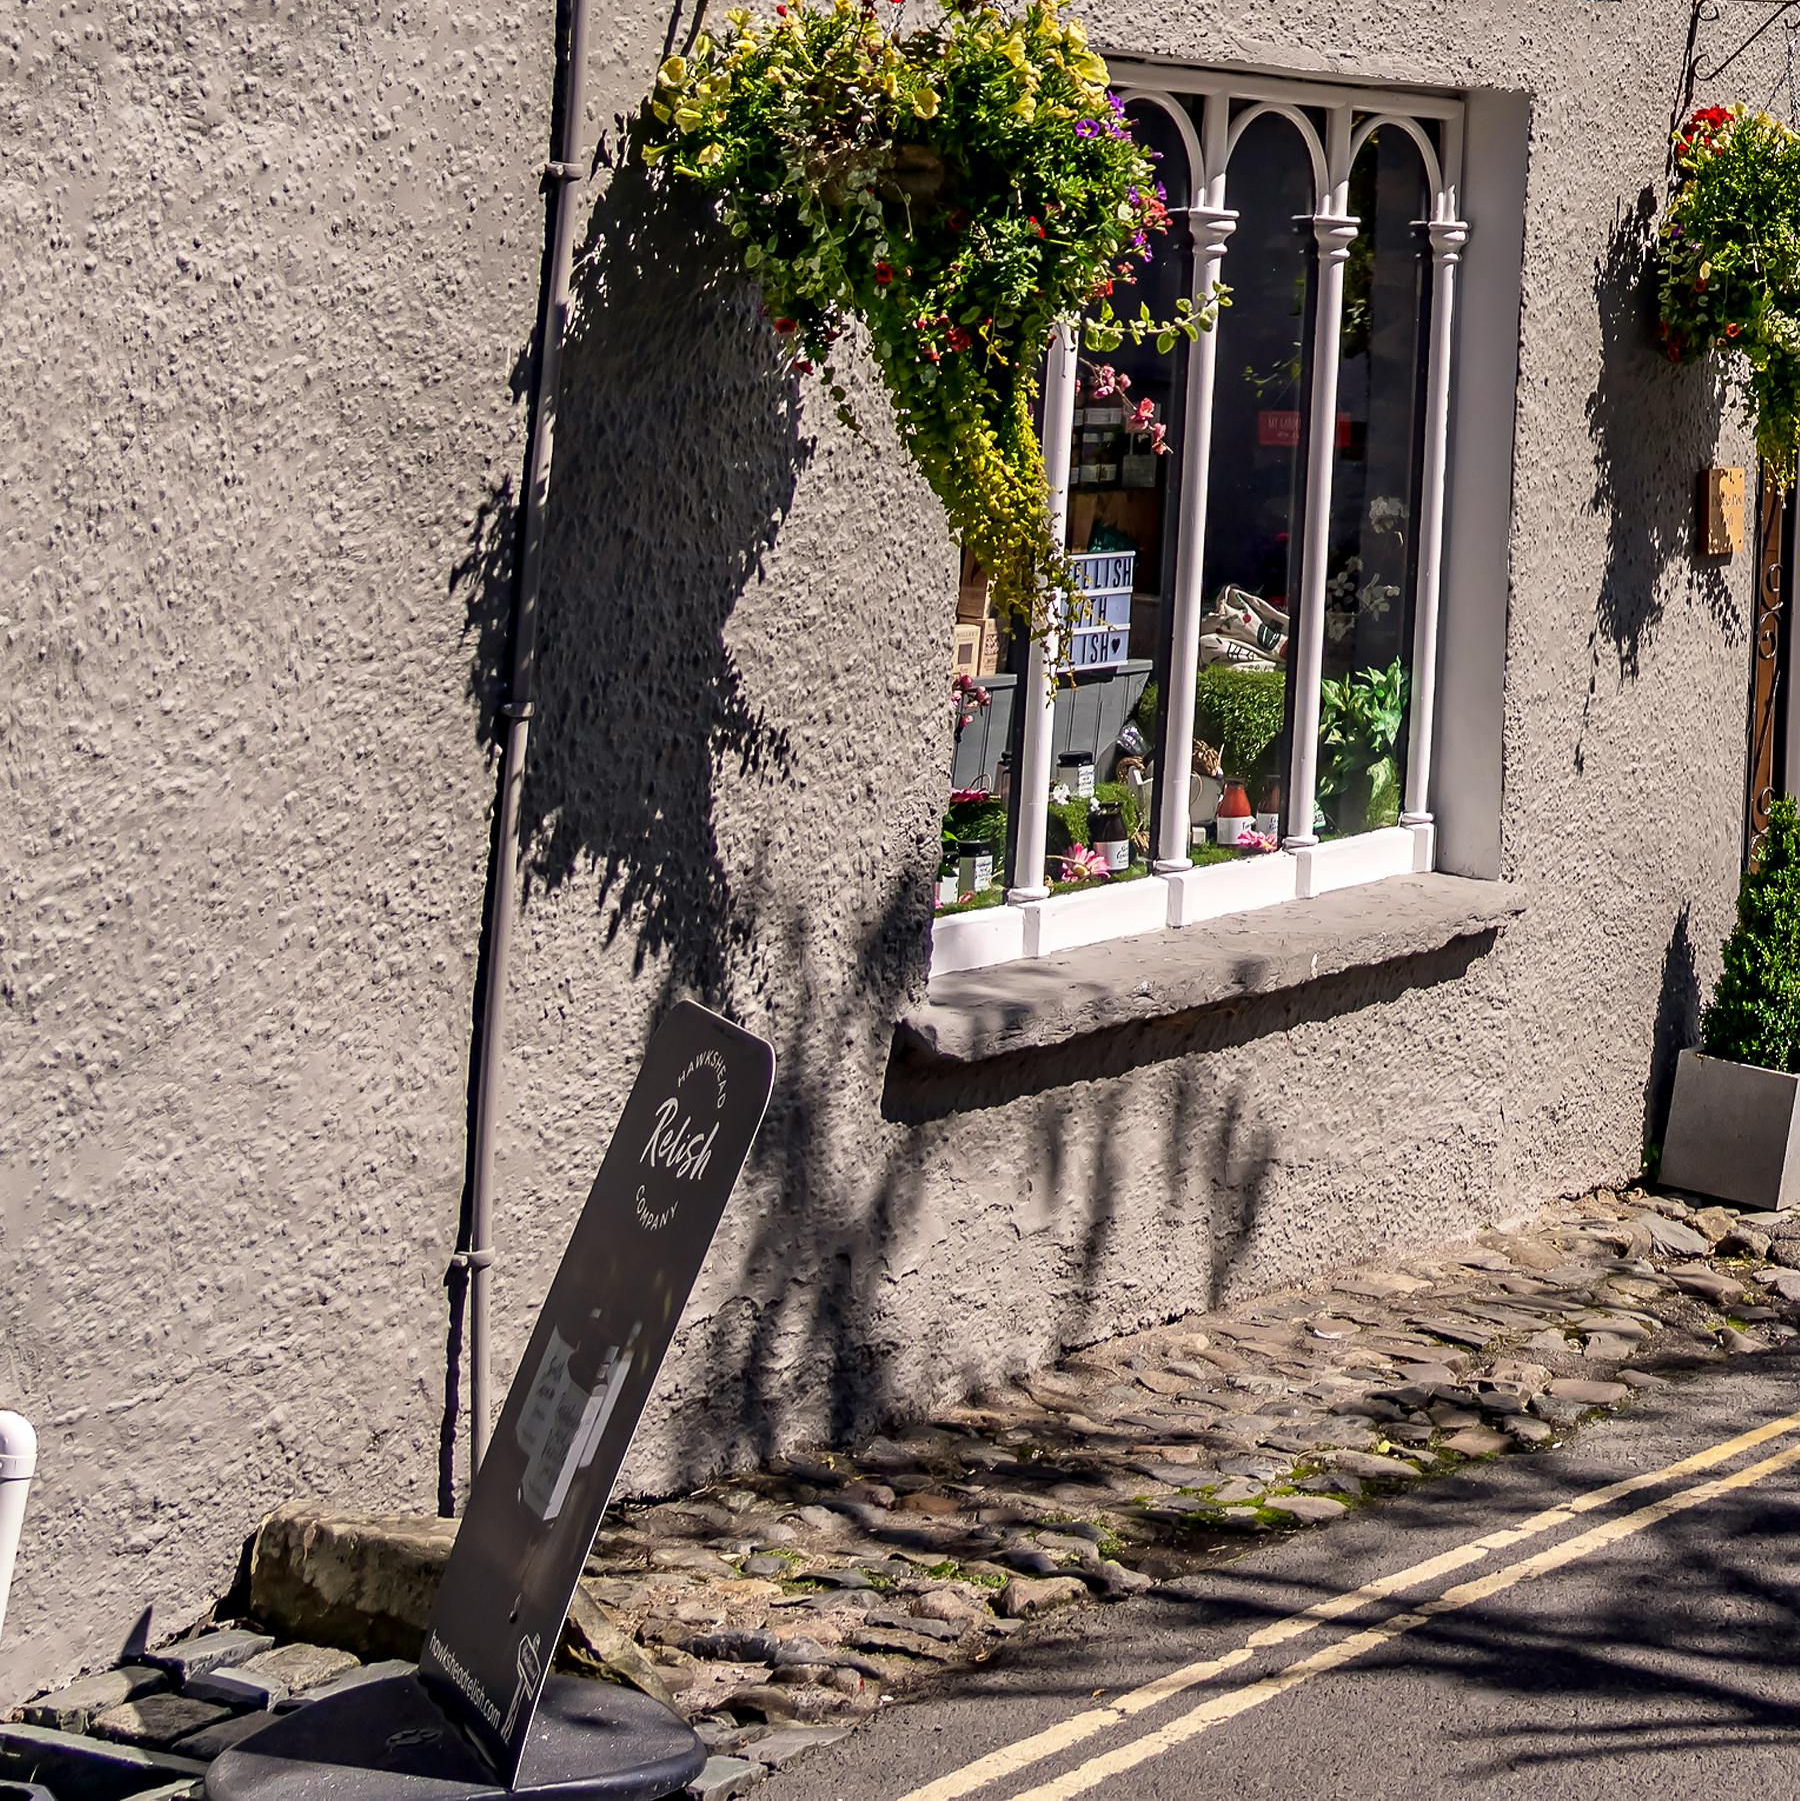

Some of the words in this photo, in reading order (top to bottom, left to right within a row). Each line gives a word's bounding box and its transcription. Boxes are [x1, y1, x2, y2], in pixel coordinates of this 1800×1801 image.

[677, 1049, 729, 1109] HAWKSHEAD
[639, 1097, 720, 1181] Relish
[635, 1184, 680, 1231] COMPANY
[428, 1628, 502, 1731] hawksheadrelish.com
